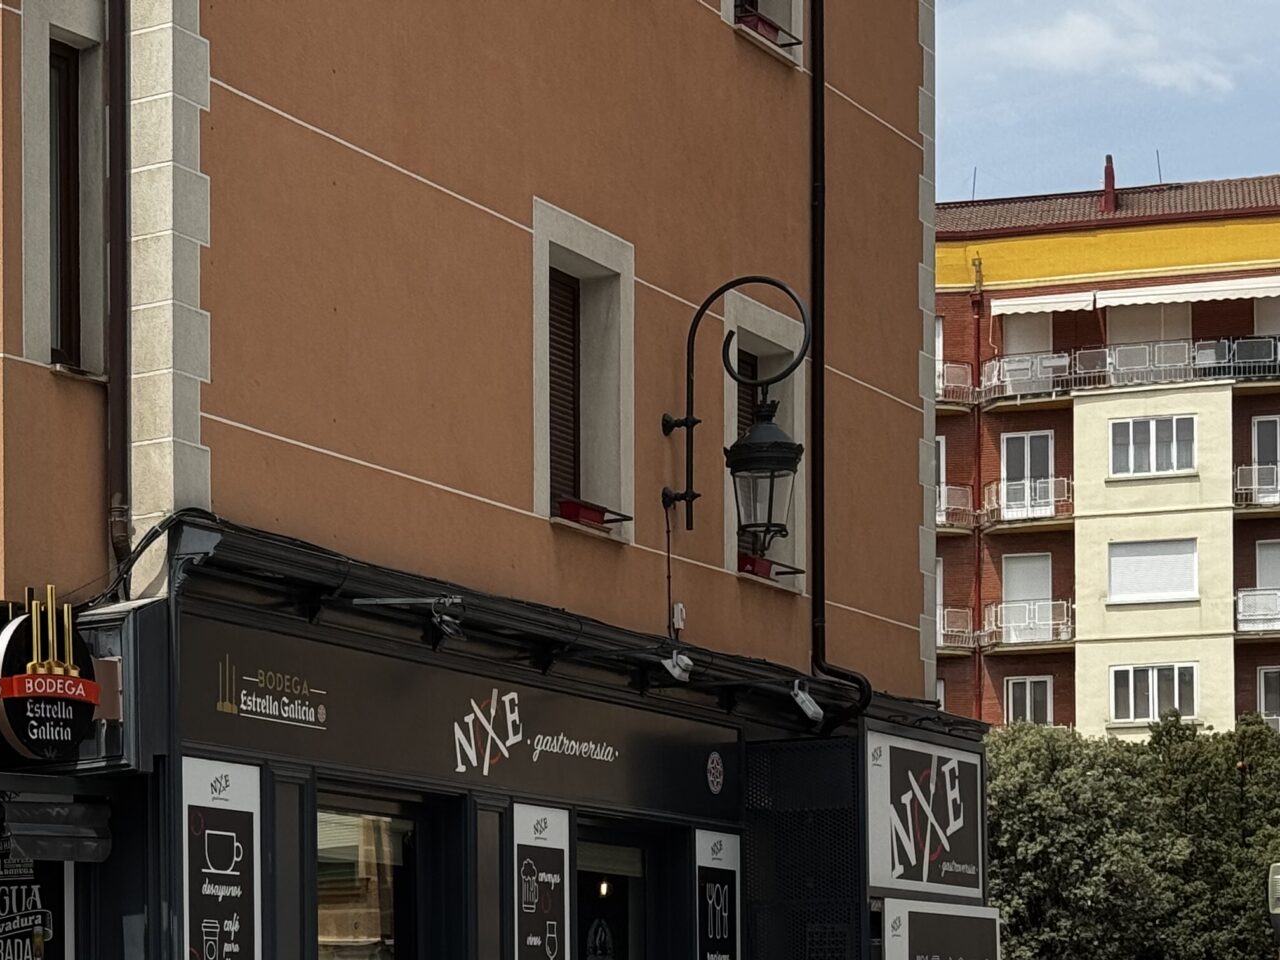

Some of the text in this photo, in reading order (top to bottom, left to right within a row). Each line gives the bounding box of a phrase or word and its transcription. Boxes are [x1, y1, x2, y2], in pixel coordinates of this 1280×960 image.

[25, 678, 86, 697] BODEGA
[258, 669, 309, 697] BODEGA
[26, 699, 73, 720] Estrella
[240, 689, 315, 722] Estrella Galicia
[28, 720, 71, 741] Galicia
